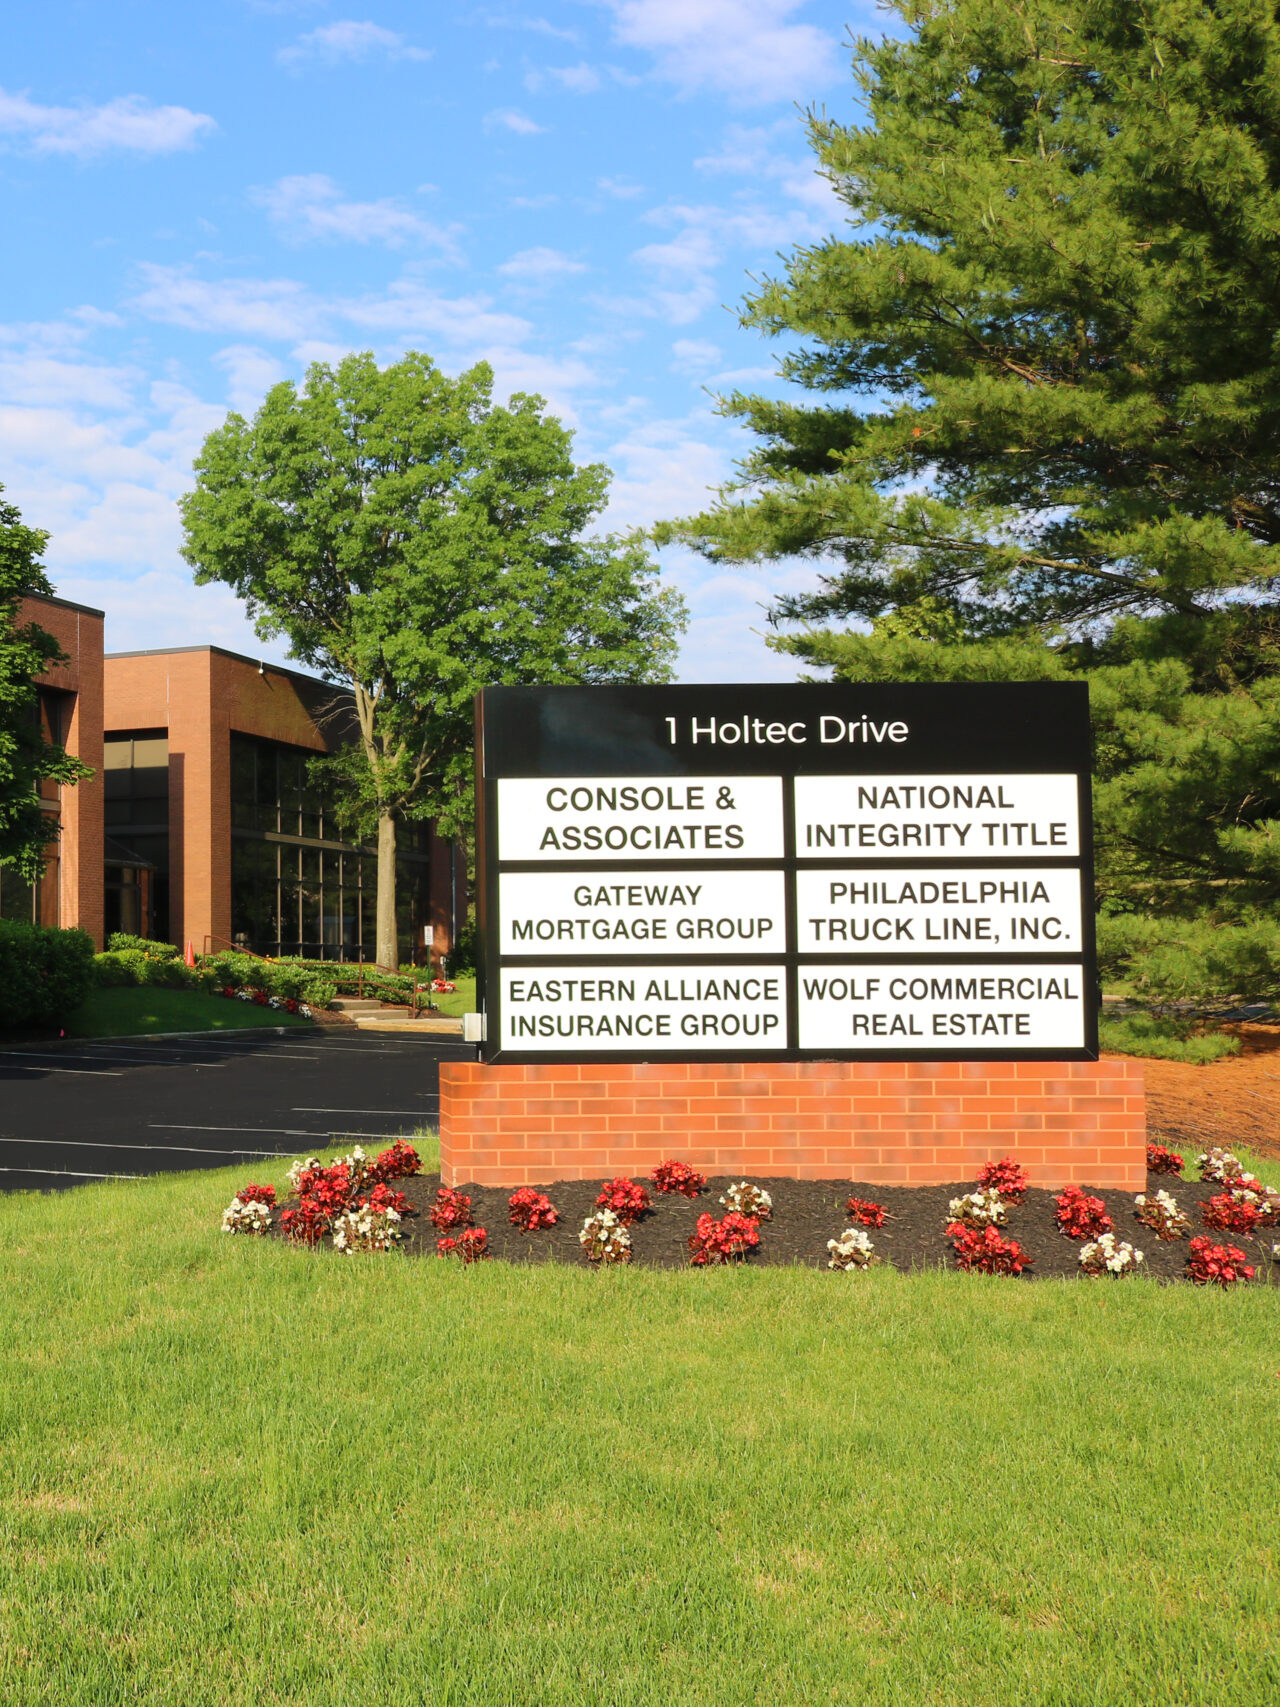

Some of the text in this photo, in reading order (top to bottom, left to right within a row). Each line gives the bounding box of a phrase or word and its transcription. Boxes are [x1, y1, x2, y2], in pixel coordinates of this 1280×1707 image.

[665, 714, 909, 745] 1 Holtec Drive
[546, 786, 736, 812] CONSOLE &
[858, 785, 1015, 809] NATIONAL
[539, 824, 744, 851] ASSOCIATES
[806, 822, 1068, 847] INTEGRITY TITLE
[574, 885, 702, 907] GATEWAY
[830, 881, 1050, 904] PHILADELPHIA
[512, 918, 773, 940] MORTGAGE GROUP
[808, 916, 1071, 943] TRUCK LINE, INC.
[510, 978, 779, 1002] EASTERN ALLIANCE
[803, 977, 1079, 1001] WOLF COMMERCIAL
[511, 1013, 779, 1037] INSURANCE GROUP
[852, 1013, 1031, 1036] REAL ESTATE
